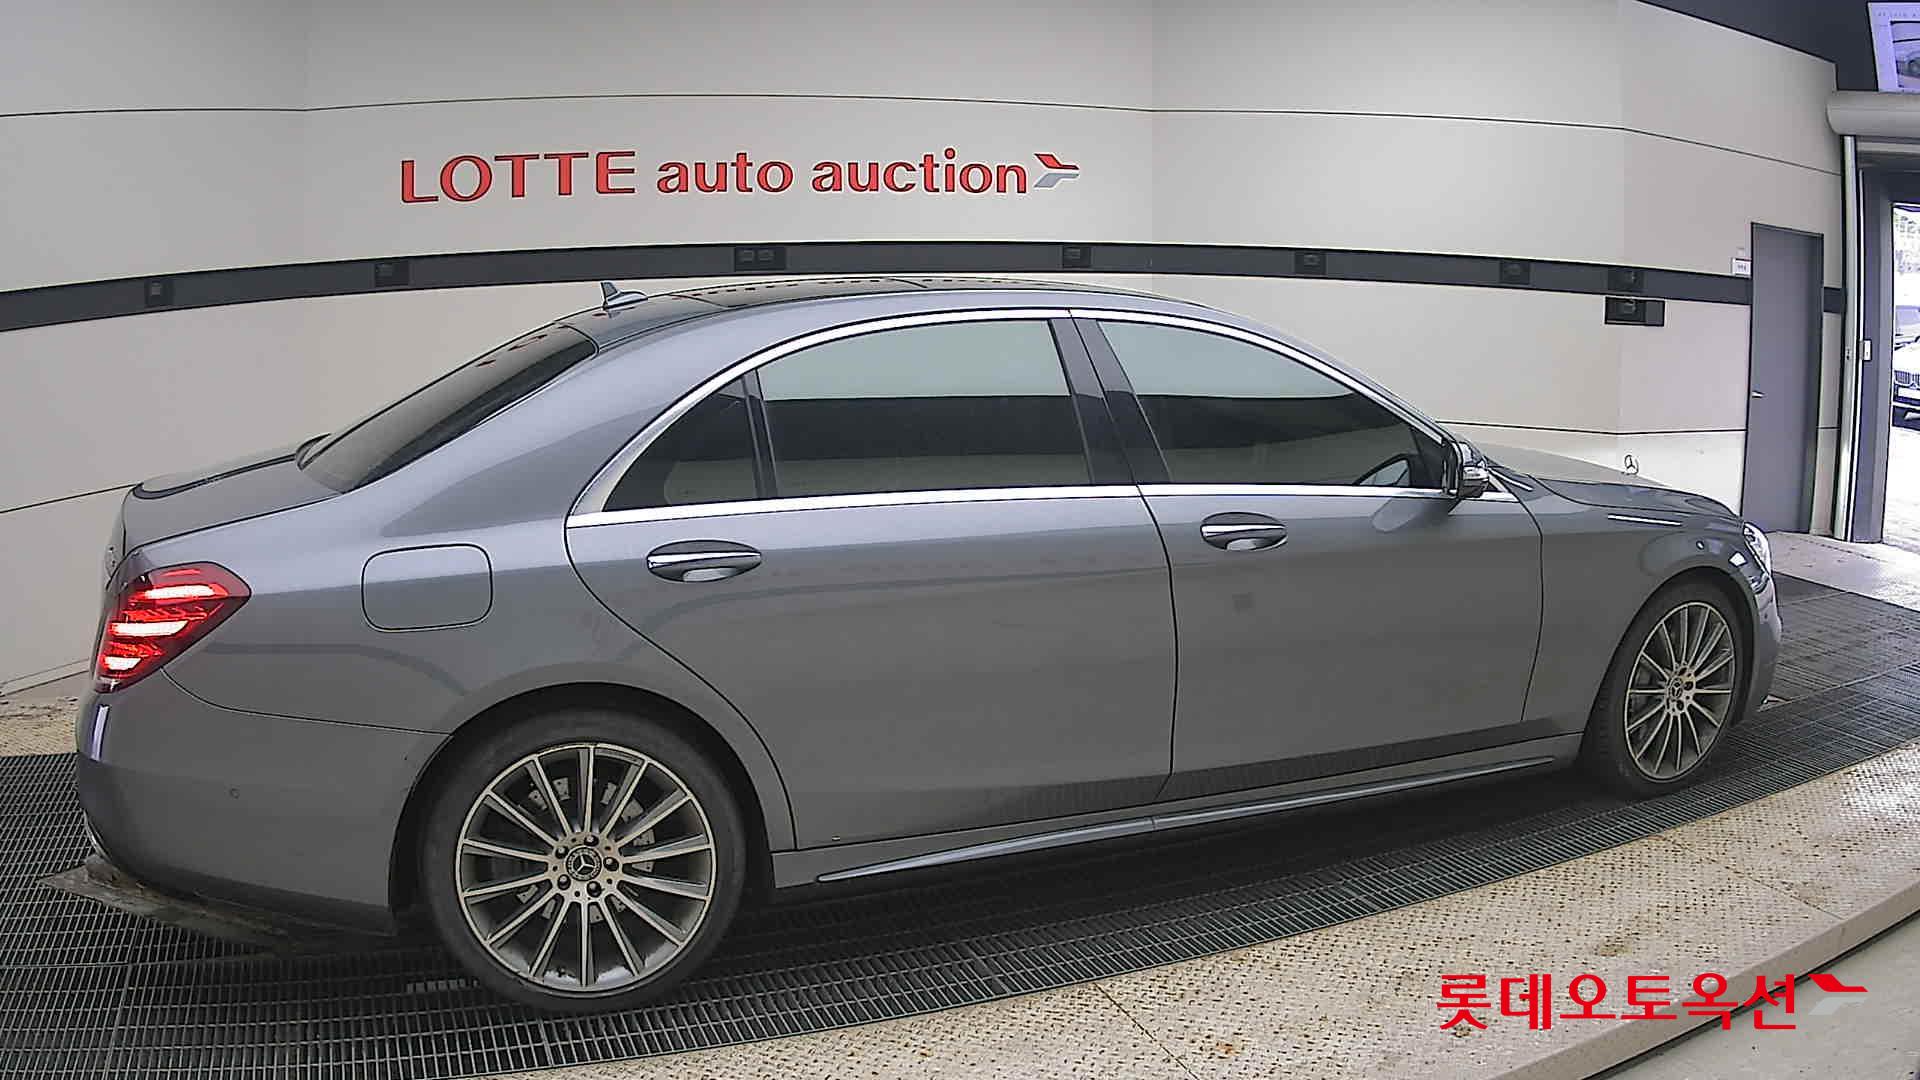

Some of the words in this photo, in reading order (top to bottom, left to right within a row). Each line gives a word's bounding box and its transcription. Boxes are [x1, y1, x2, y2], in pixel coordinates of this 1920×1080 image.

[401, 150, 636, 204] LOTTE
[656, 152, 795, 194] auto
[810, 147, 1028, 195] auction
